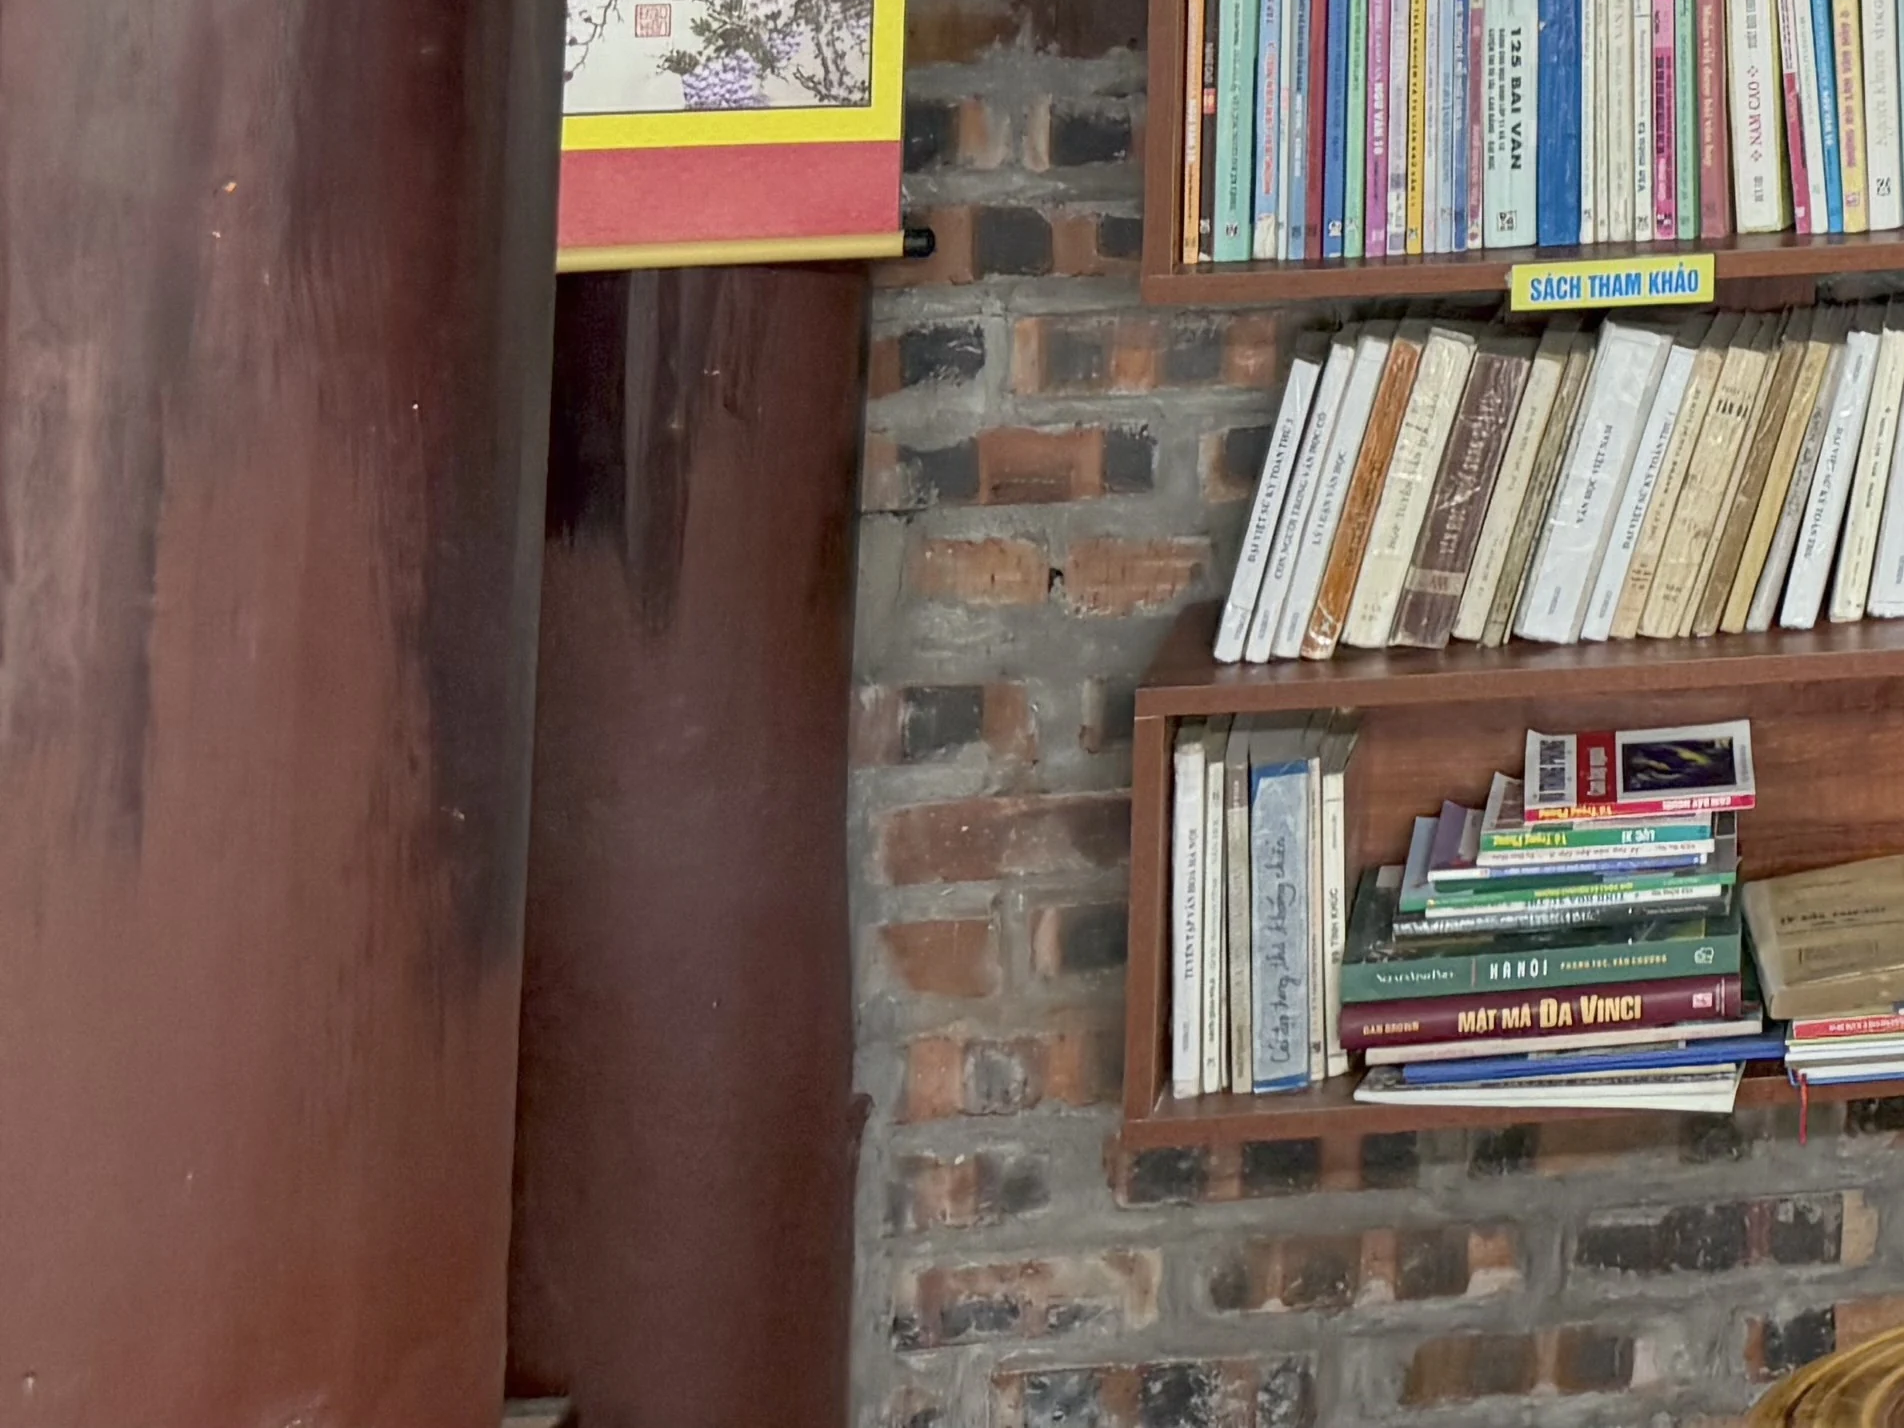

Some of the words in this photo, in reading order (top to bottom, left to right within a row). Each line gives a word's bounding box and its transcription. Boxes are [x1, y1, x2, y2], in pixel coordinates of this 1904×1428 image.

[1531, 273, 1581, 301] SÁCH
[1588, 272, 1641, 298] THAM
[1649, 262, 1698, 294] KHẢO
[1459, 1008, 1497, 1035] MẬT
[1502, 1005, 1532, 1029] MÃ
[1580, 995, 1642, 1024] VINCI
